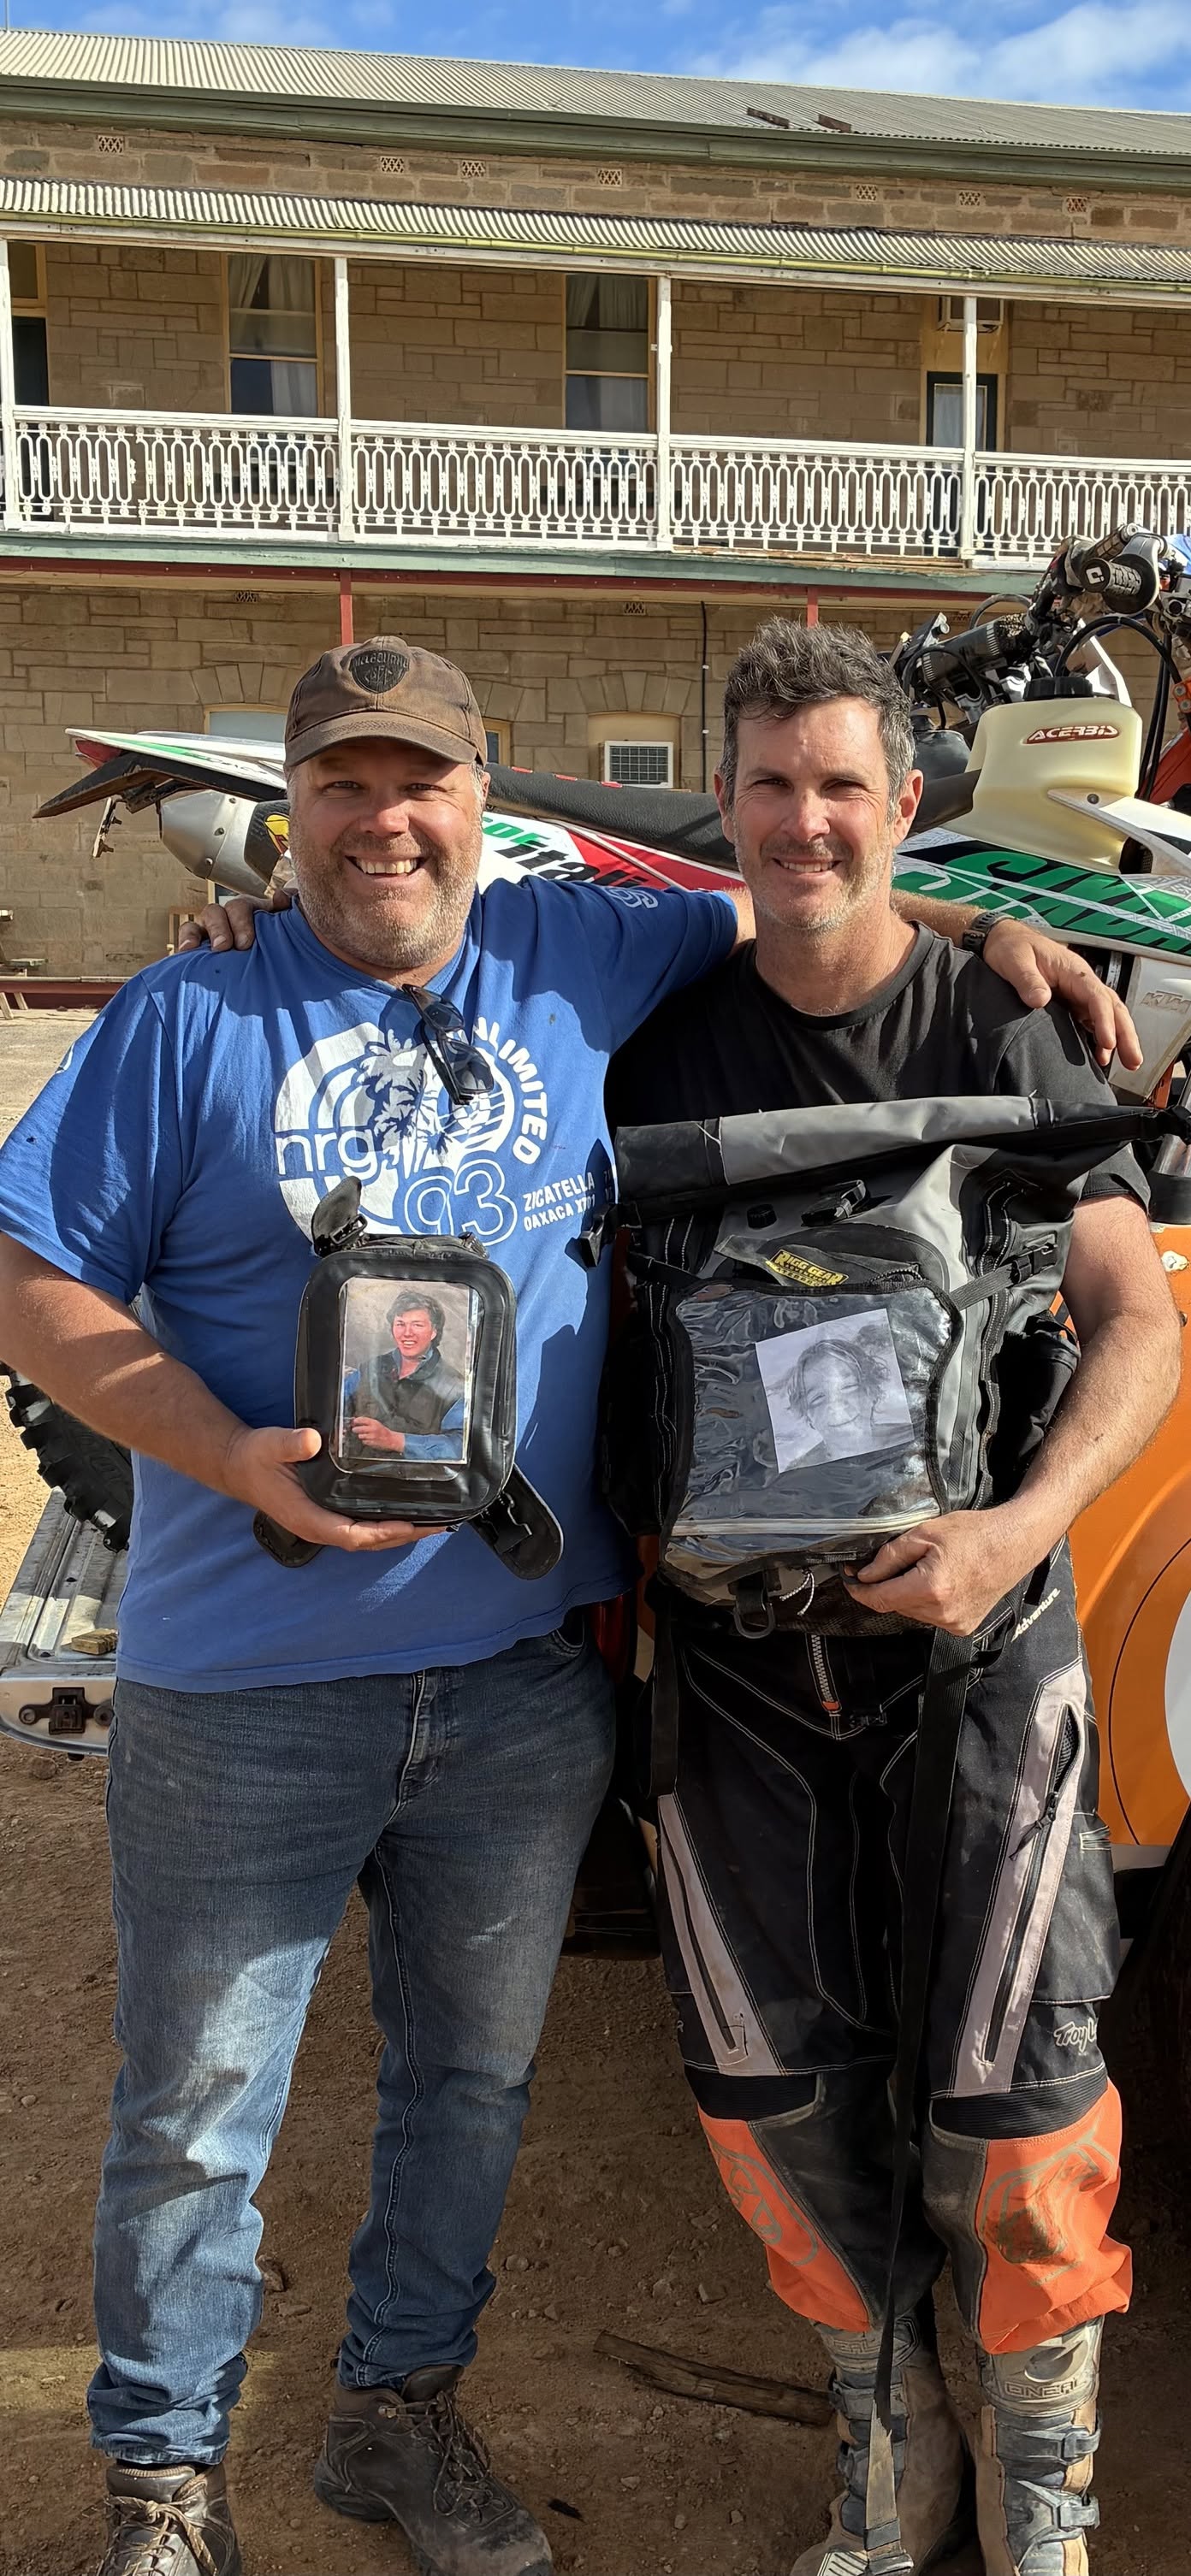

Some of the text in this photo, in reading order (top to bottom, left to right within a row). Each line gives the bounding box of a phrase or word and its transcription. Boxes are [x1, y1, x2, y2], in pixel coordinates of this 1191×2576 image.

[471, 1016, 548, 1165] NLIMITED
[275, 1128, 378, 1180] nrg
[404, 1158, 518, 1246] 93
[523, 1202, 574, 1232] OAXACA
[774, 1251, 843, 1285] RIGG GEAR
[1053, 2021, 1087, 2053] Troy
